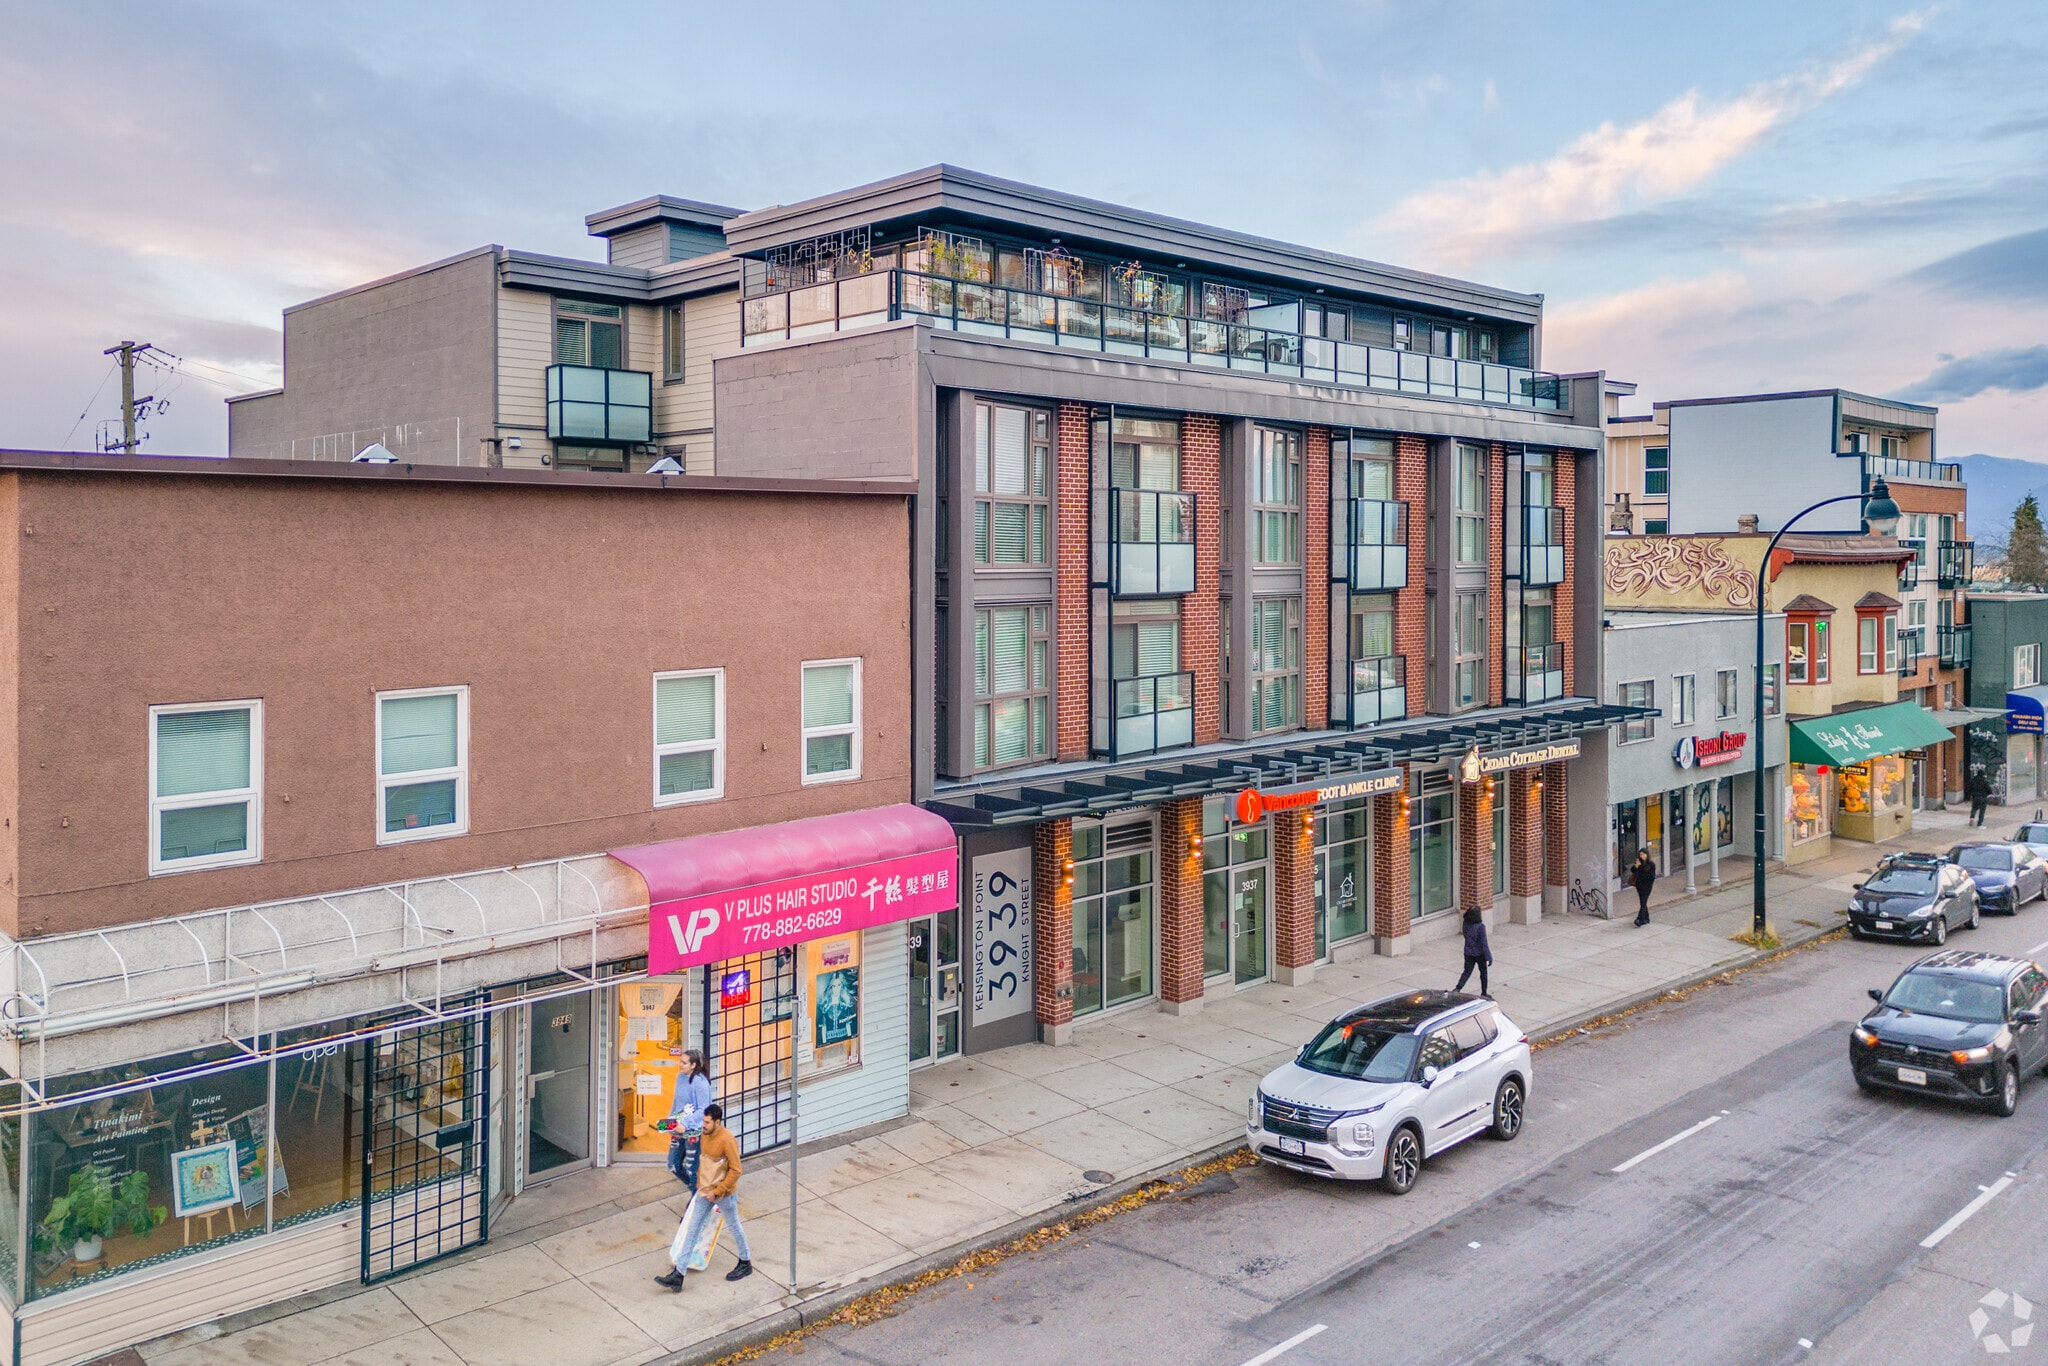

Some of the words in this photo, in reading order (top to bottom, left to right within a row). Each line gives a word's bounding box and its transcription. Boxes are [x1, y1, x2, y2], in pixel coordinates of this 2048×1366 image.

[1480, 756, 1510, 772] CEDAR
[1510, 748, 1548, 767] COTTAGE
[1547, 744, 1580, 760] DENTAL
[1694, 736, 1721, 757] ISHONI
[1721, 731, 1747, 751] GROUP
[1317, 788, 1341, 802] FOOT
[1340, 785, 1347, 796] &
[1347, 780, 1374, 795] ANKLE
[1374, 775, 1400, 790] CLINIC
[725, 902, 734, 922] V
[737, 896, 772, 920] PLUS
[776, 889, 808, 912] HAIR
[811, 877, 857, 905] STUDIO
[975, 871, 984, 913] POINT
[1241, 879, 1258, 892] 3937
[1021, 878, 1030, 926] STREET
[667, 907, 720, 955] VP
[742, 907, 842, 944] 778-882-6629
[988, 870, 1018, 1001] 3939
[975, 919, 984, 1011] KENSINGTON
[1021, 933, 1030, 983] KNIGHT
[722, 991, 749, 1007] OPEN
[192, 1094, 221, 1107] Design
[209, 1106, 227, 1115] Design
[93, 1110, 143, 1129] Tinakimi
[93, 1133, 110, 1144] Art
[110, 1125, 149, 1141] Painting
